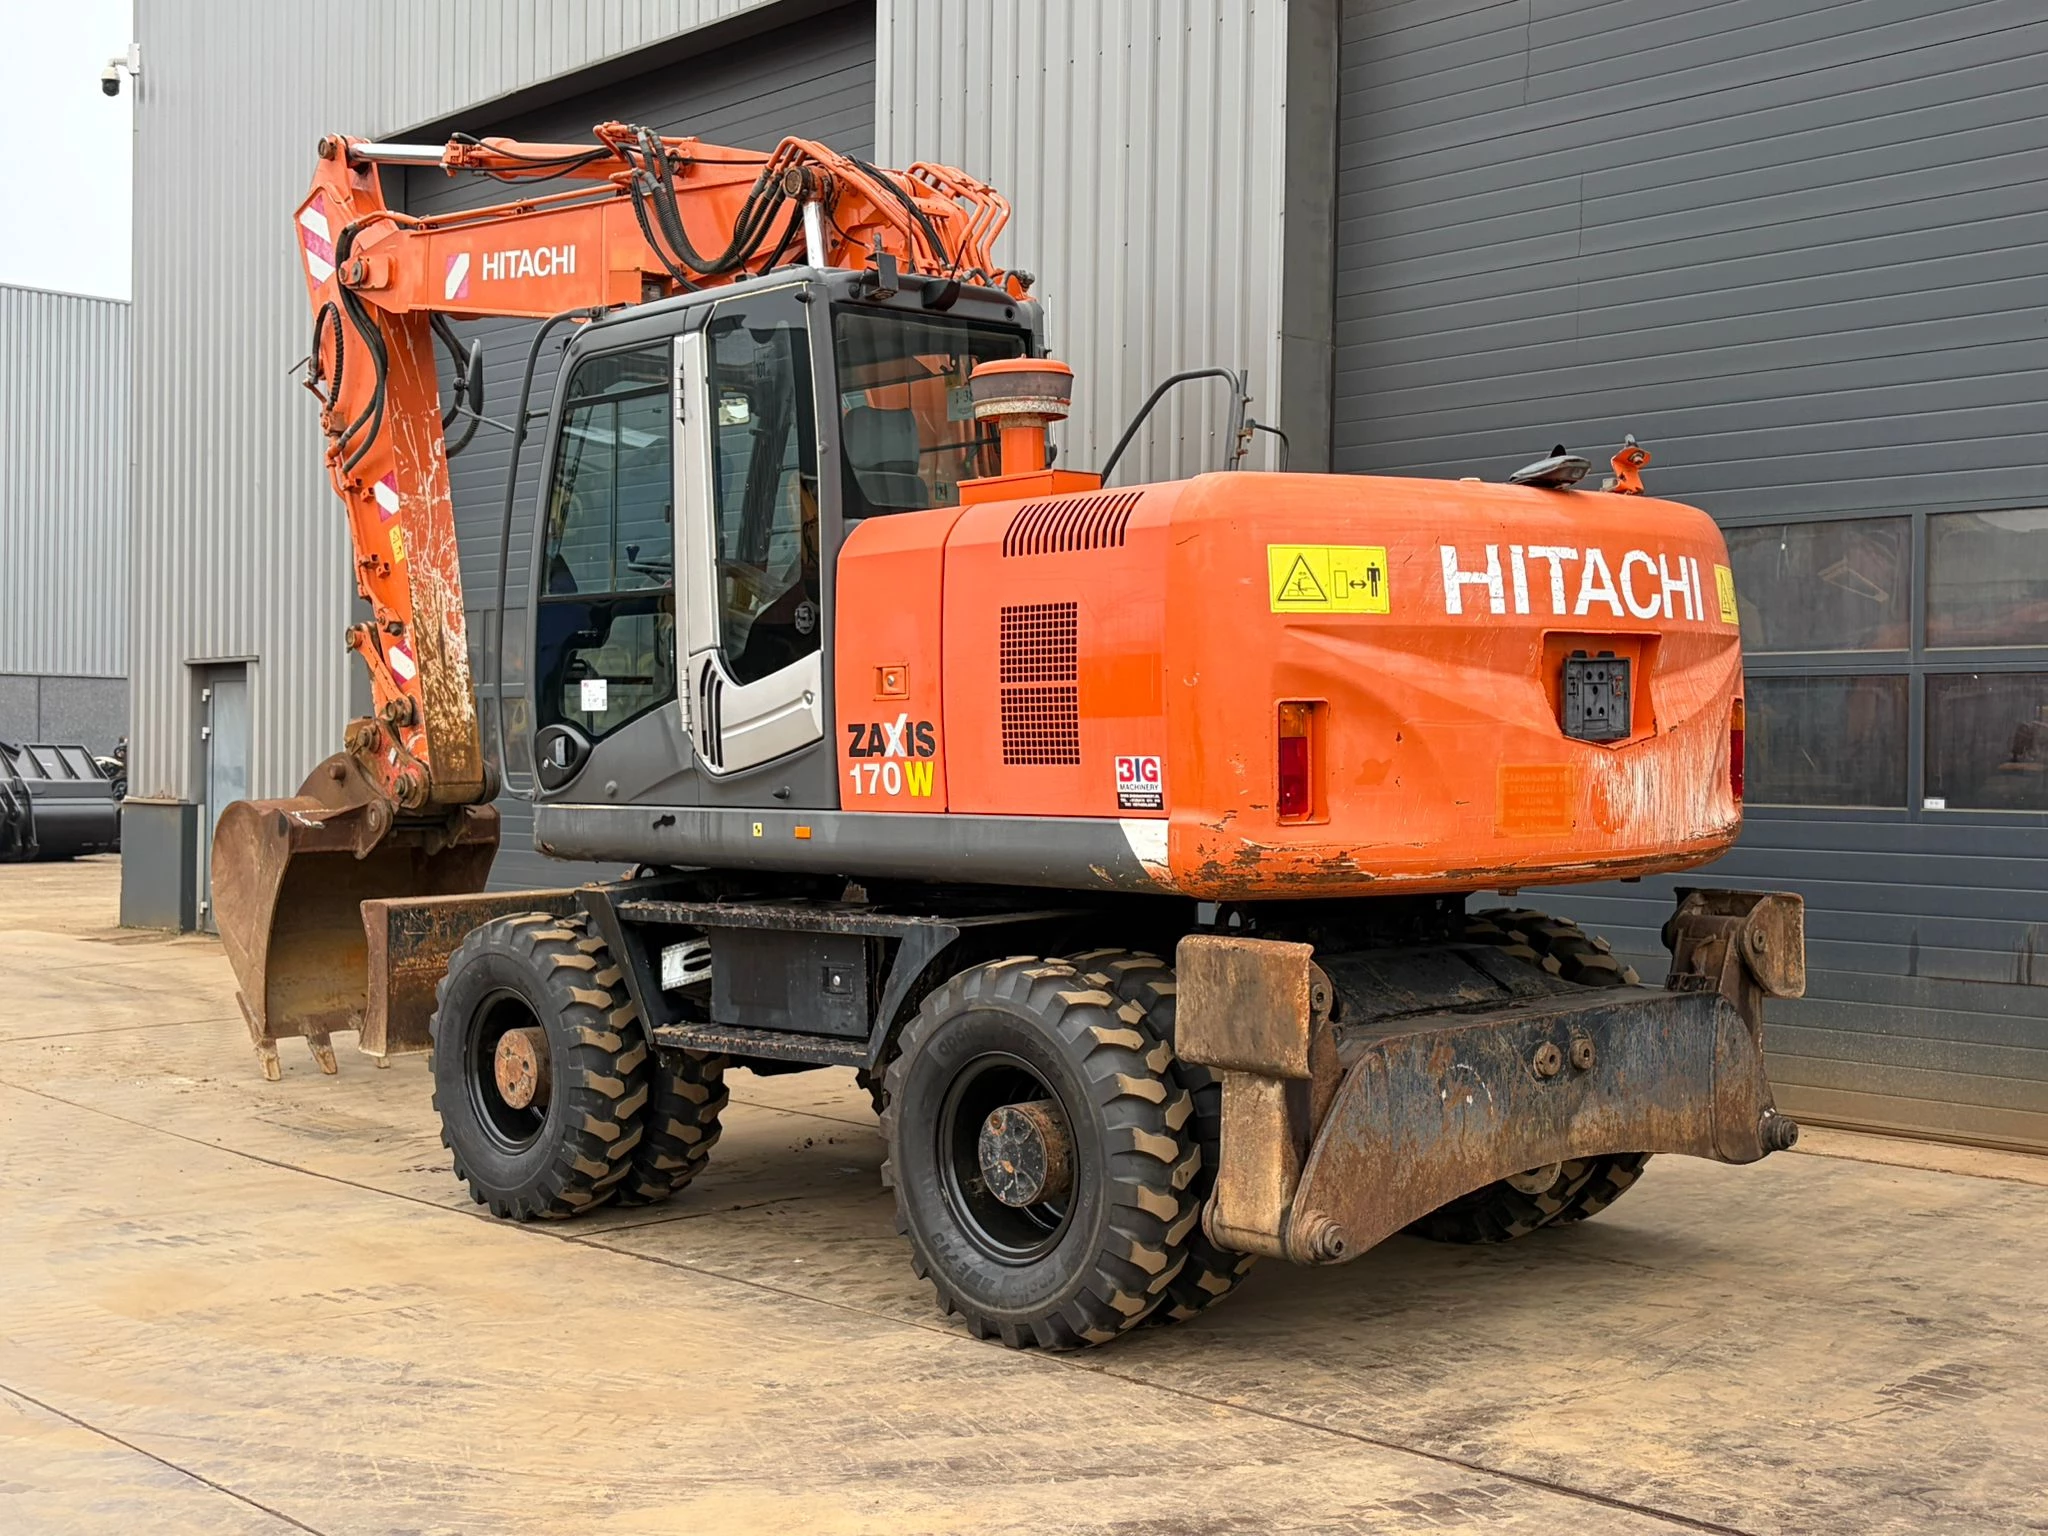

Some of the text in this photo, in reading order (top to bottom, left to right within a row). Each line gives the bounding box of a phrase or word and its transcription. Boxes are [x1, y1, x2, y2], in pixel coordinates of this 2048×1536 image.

[482, 245, 576, 280] HITACHI
[1440, 544, 1704, 621] HITACHI
[848, 713, 935, 757] ZAXIS
[849, 761, 934, 797] 170W
